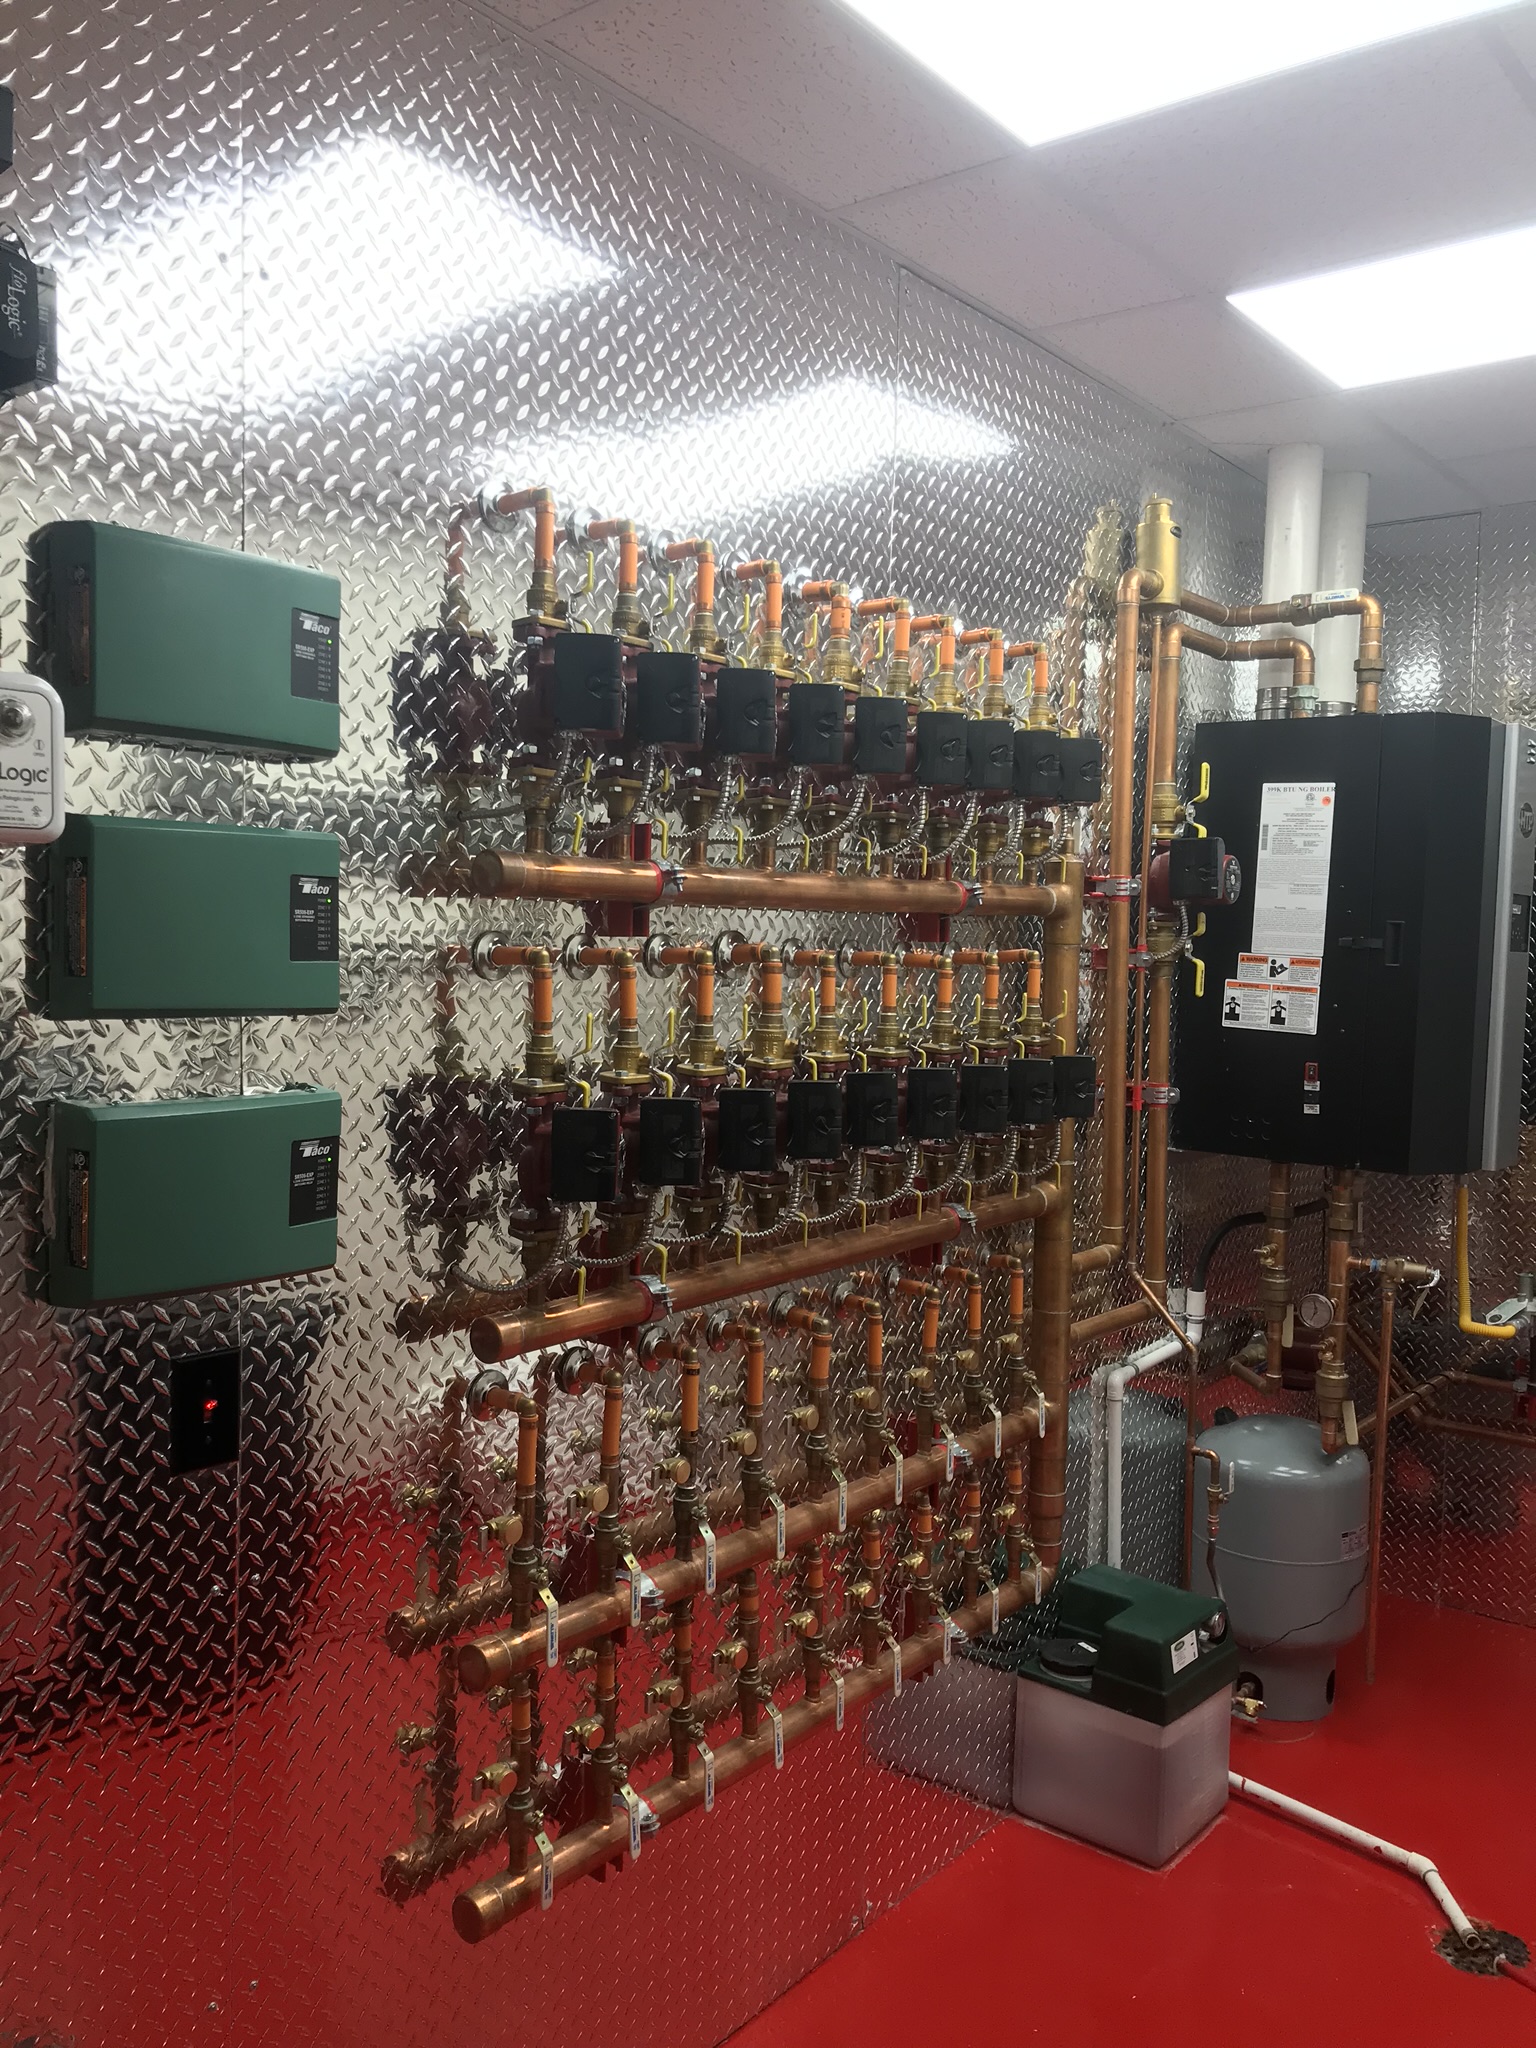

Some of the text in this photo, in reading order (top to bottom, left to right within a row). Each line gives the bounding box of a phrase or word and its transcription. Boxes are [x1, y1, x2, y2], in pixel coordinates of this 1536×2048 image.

[1, 262, 27, 332] floLogic
[299, 612, 330, 635] Taco
[299, 877, 330, 895] Taco
[299, 1140, 331, 1158] Taco
